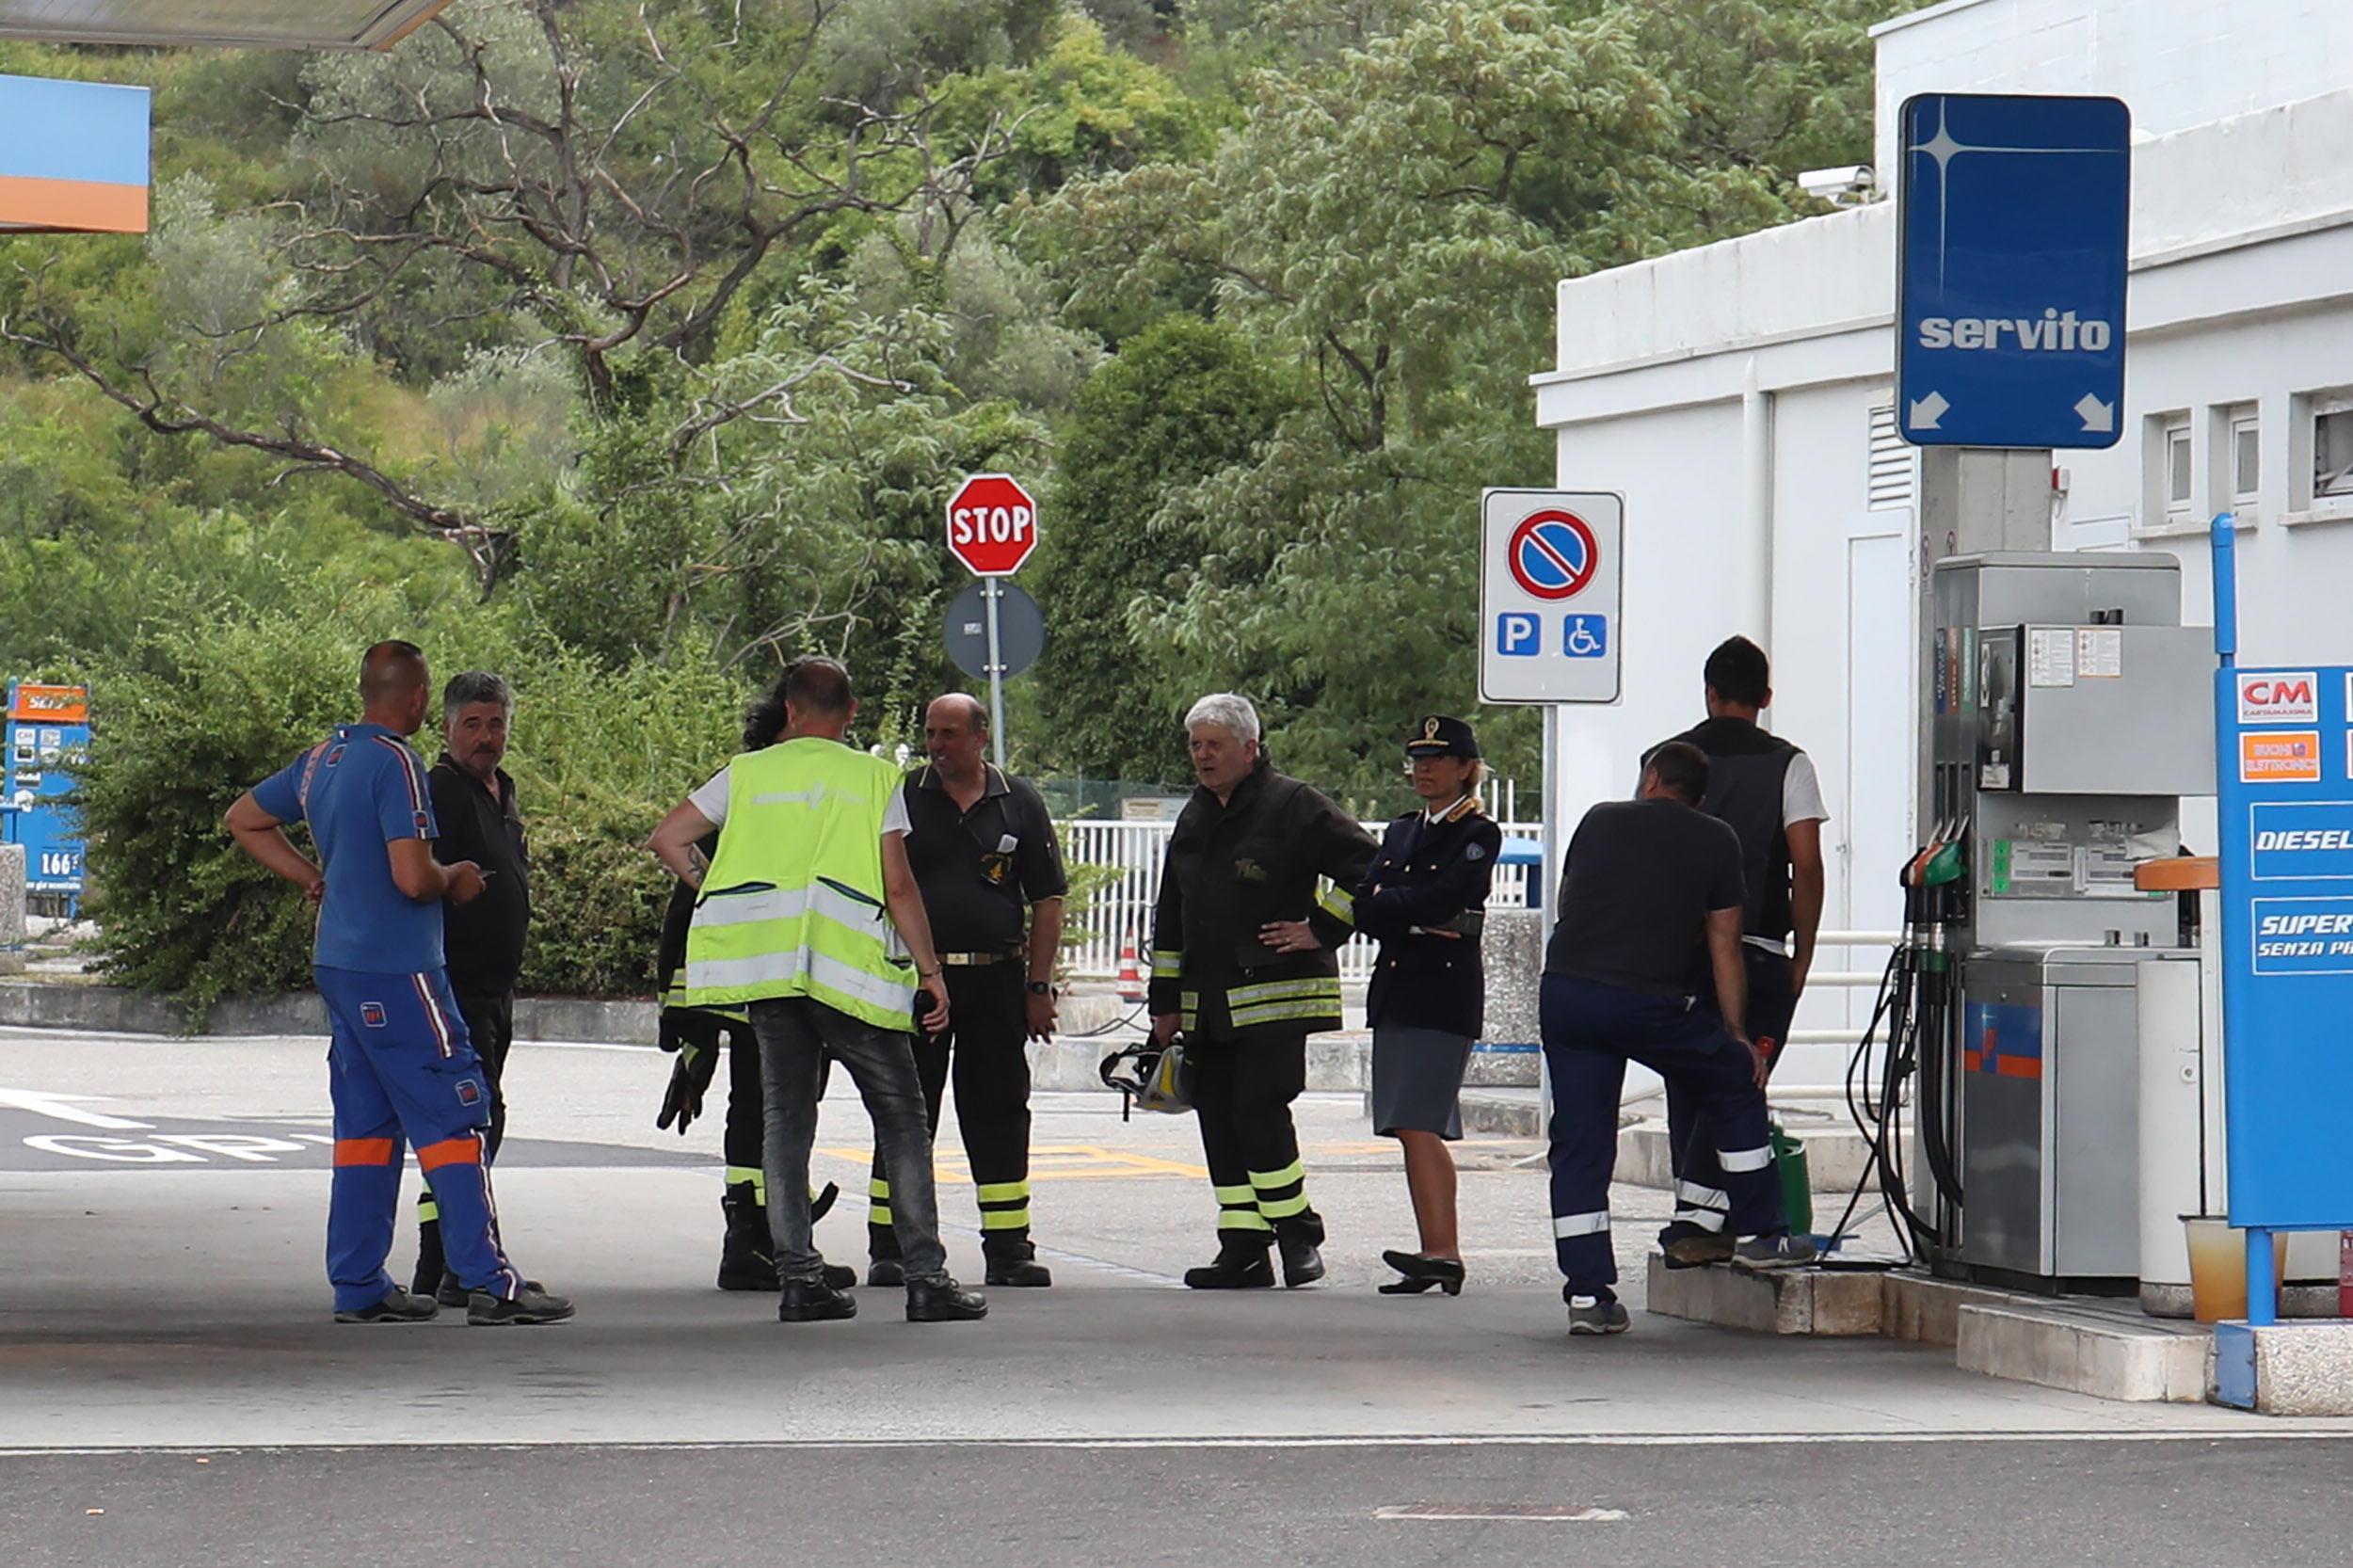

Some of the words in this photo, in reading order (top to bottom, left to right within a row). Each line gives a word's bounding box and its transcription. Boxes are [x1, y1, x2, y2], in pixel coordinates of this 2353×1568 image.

[1919, 308, 2111, 351] servito
[954, 506, 1031, 544] STOP
[1506, 617, 1532, 651] P
[2243, 680, 2312, 705] CM
[2256, 830, 2353, 851] DIESEL
[2259, 914, 2353, 936] SUPER
[2258, 941, 2325, 956] SENZA
